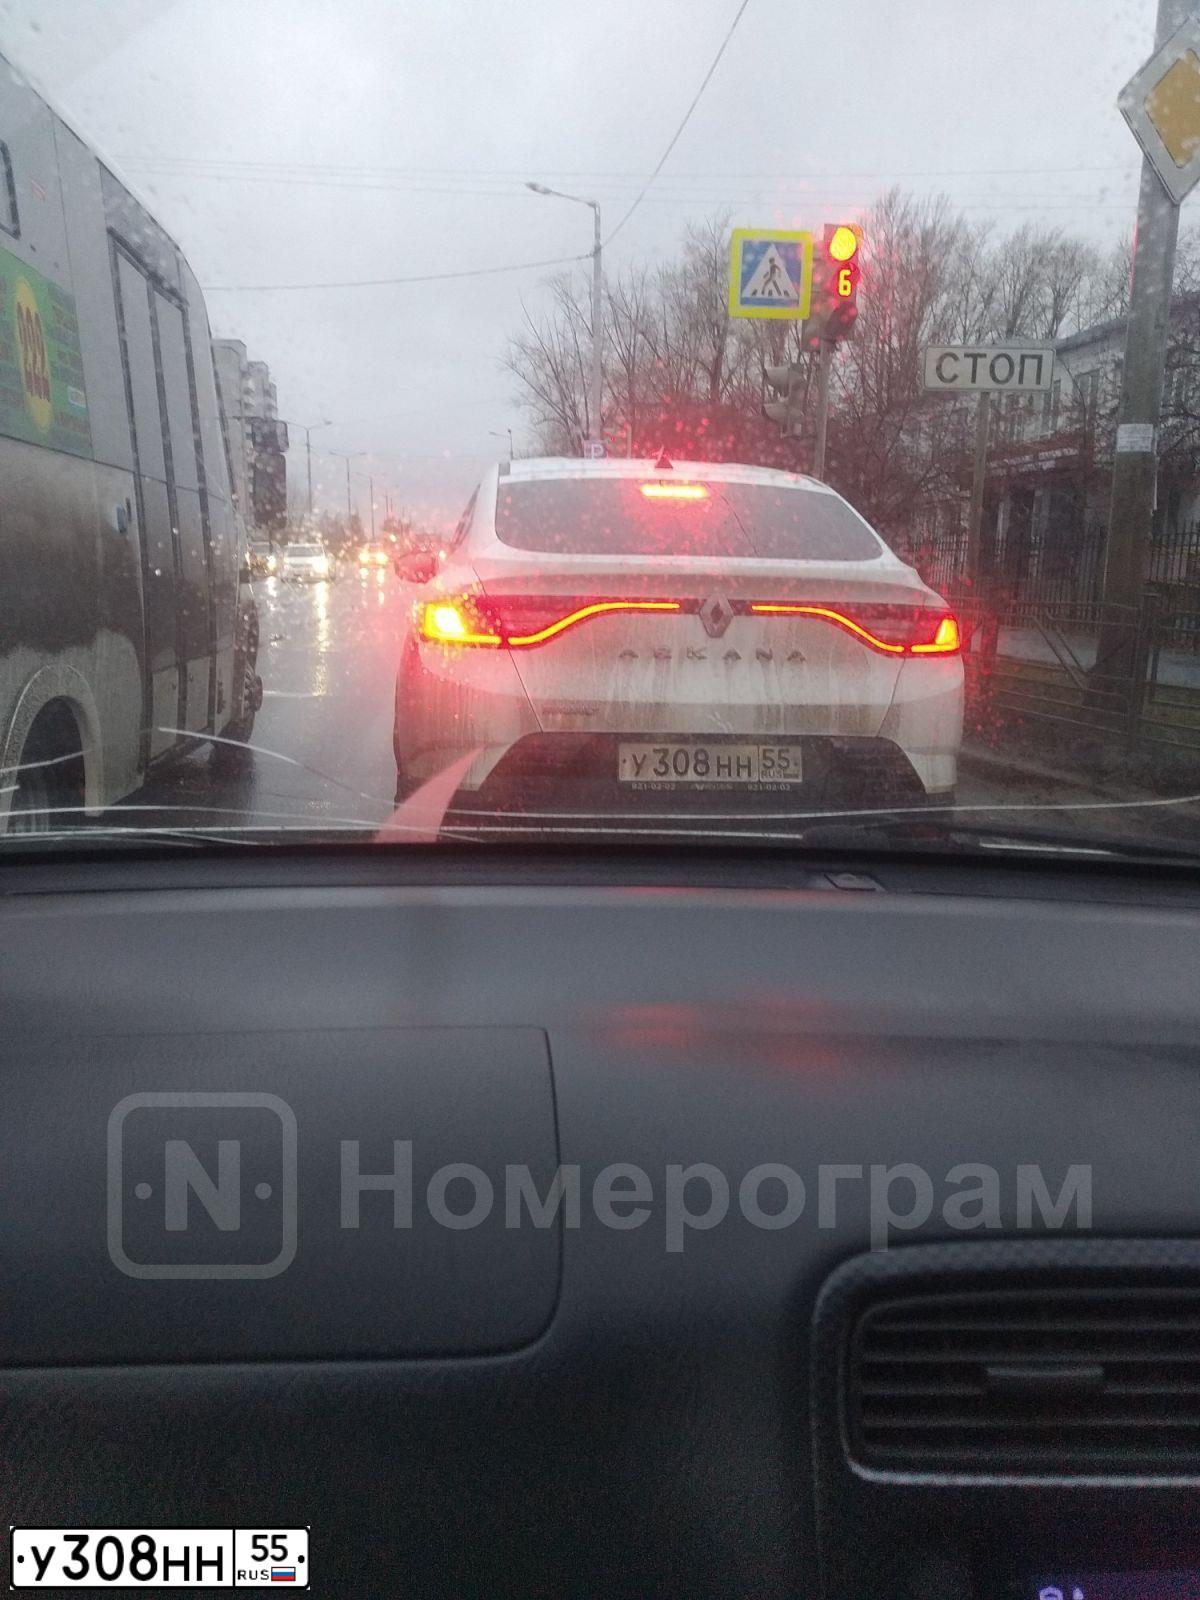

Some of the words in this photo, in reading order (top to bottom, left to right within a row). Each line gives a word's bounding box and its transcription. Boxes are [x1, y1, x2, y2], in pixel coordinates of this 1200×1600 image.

[838, 268, 852, 297] 6
[935, 351, 1043, 385] СТОП
[761, 748, 790, 770] 55
